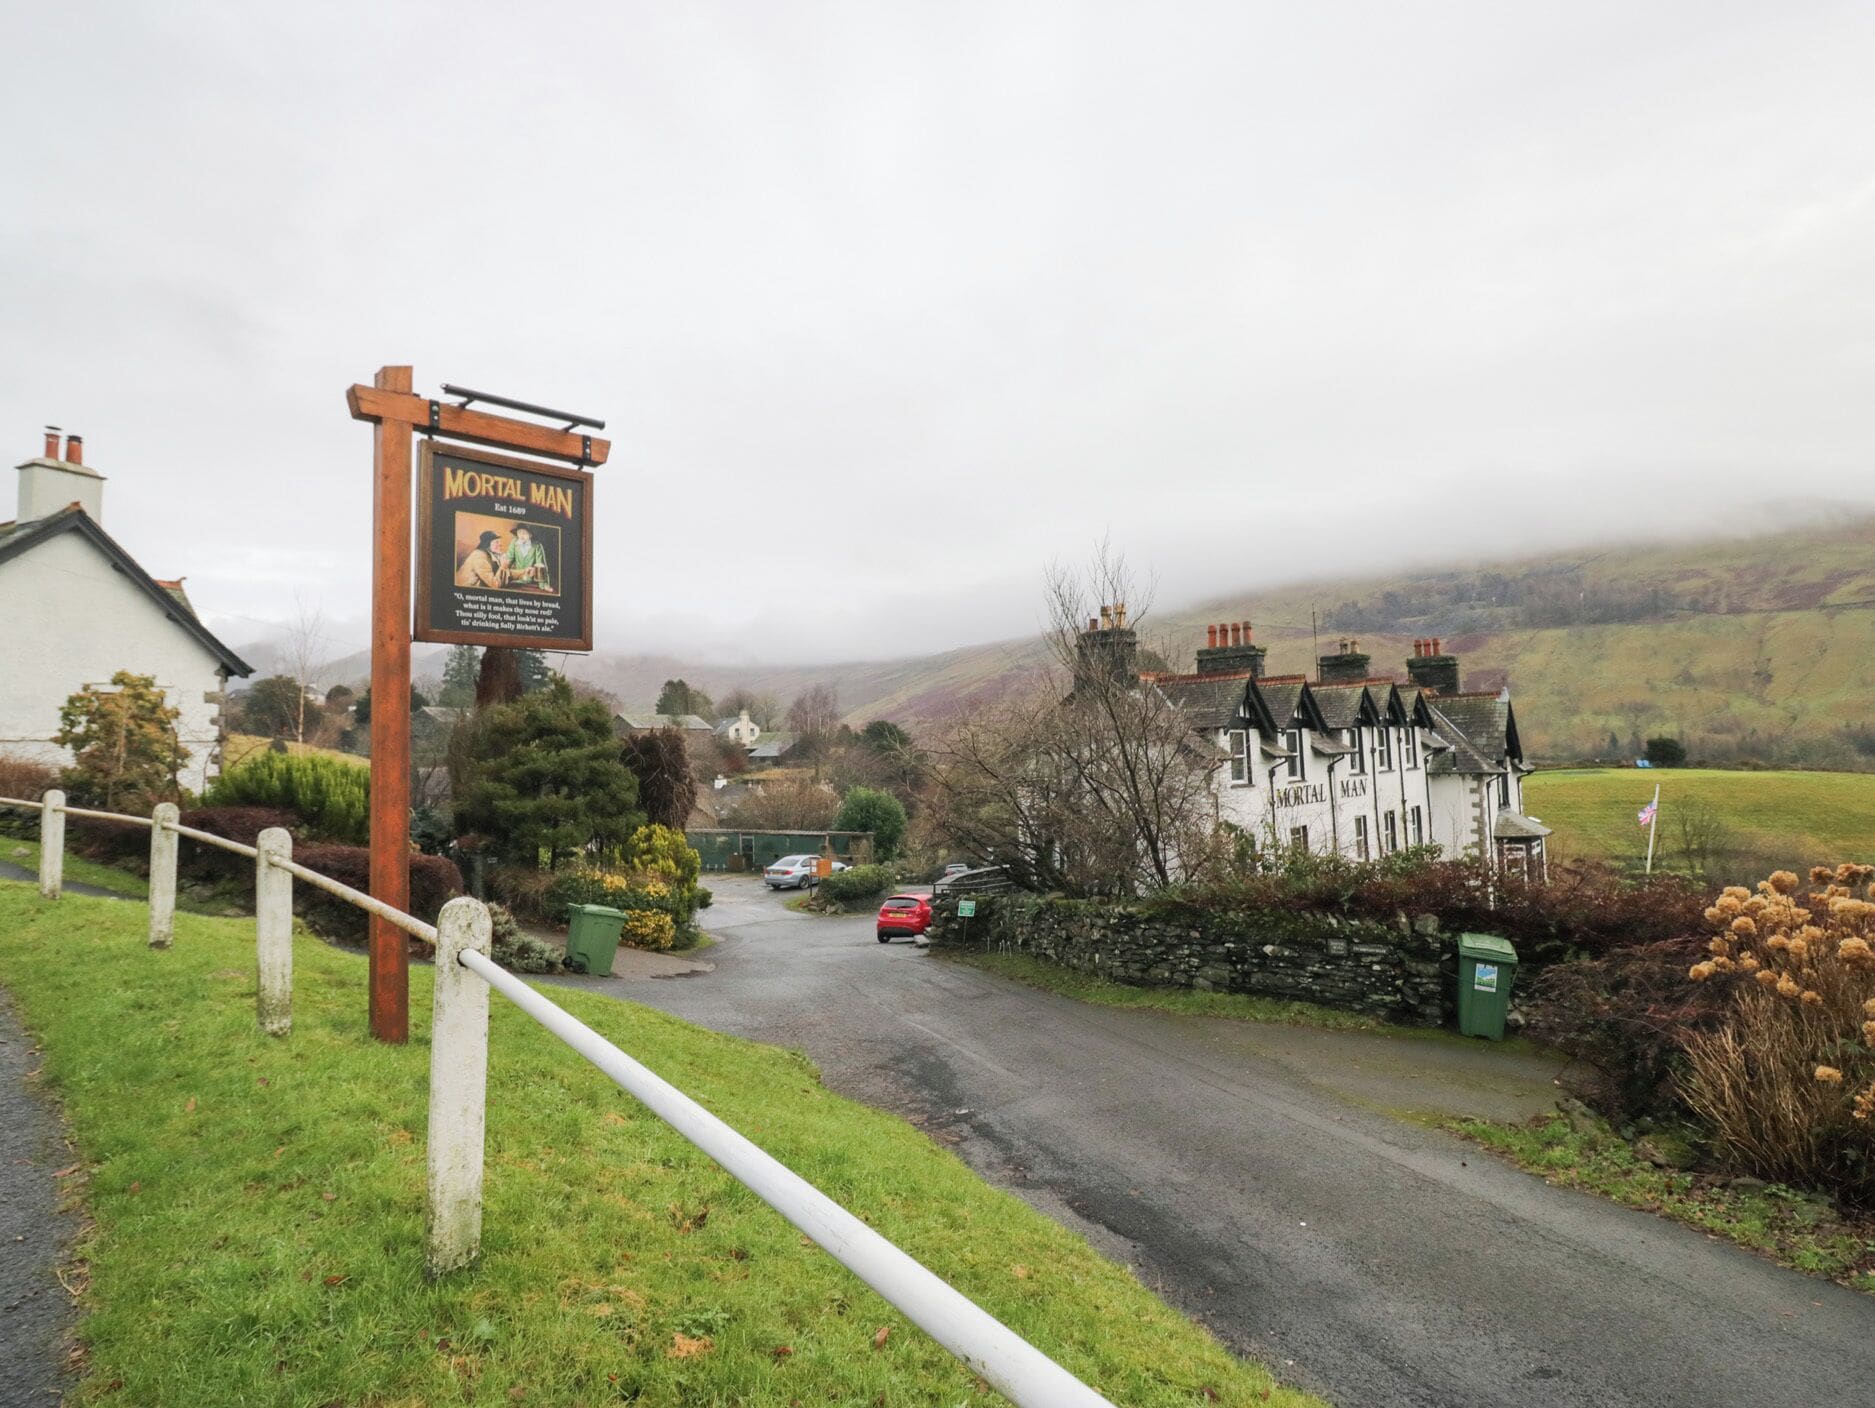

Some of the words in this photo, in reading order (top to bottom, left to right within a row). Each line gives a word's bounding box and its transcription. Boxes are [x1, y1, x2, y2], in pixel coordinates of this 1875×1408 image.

[443, 466, 526, 501] MORTAL
[530, 482, 572, 519] MAN
[495, 503, 507, 511] Est
[534, 600, 541, 608] by
[542, 601, 560, 609] bread,
[474, 612, 487, 620] silly
[488, 612, 502, 620] fool,
[472, 620, 499, 629] drinking
[500, 622, 514, 630] Sally
[1276, 783, 1327, 808] MORTAL
[1341, 778, 1368, 798] MAN
